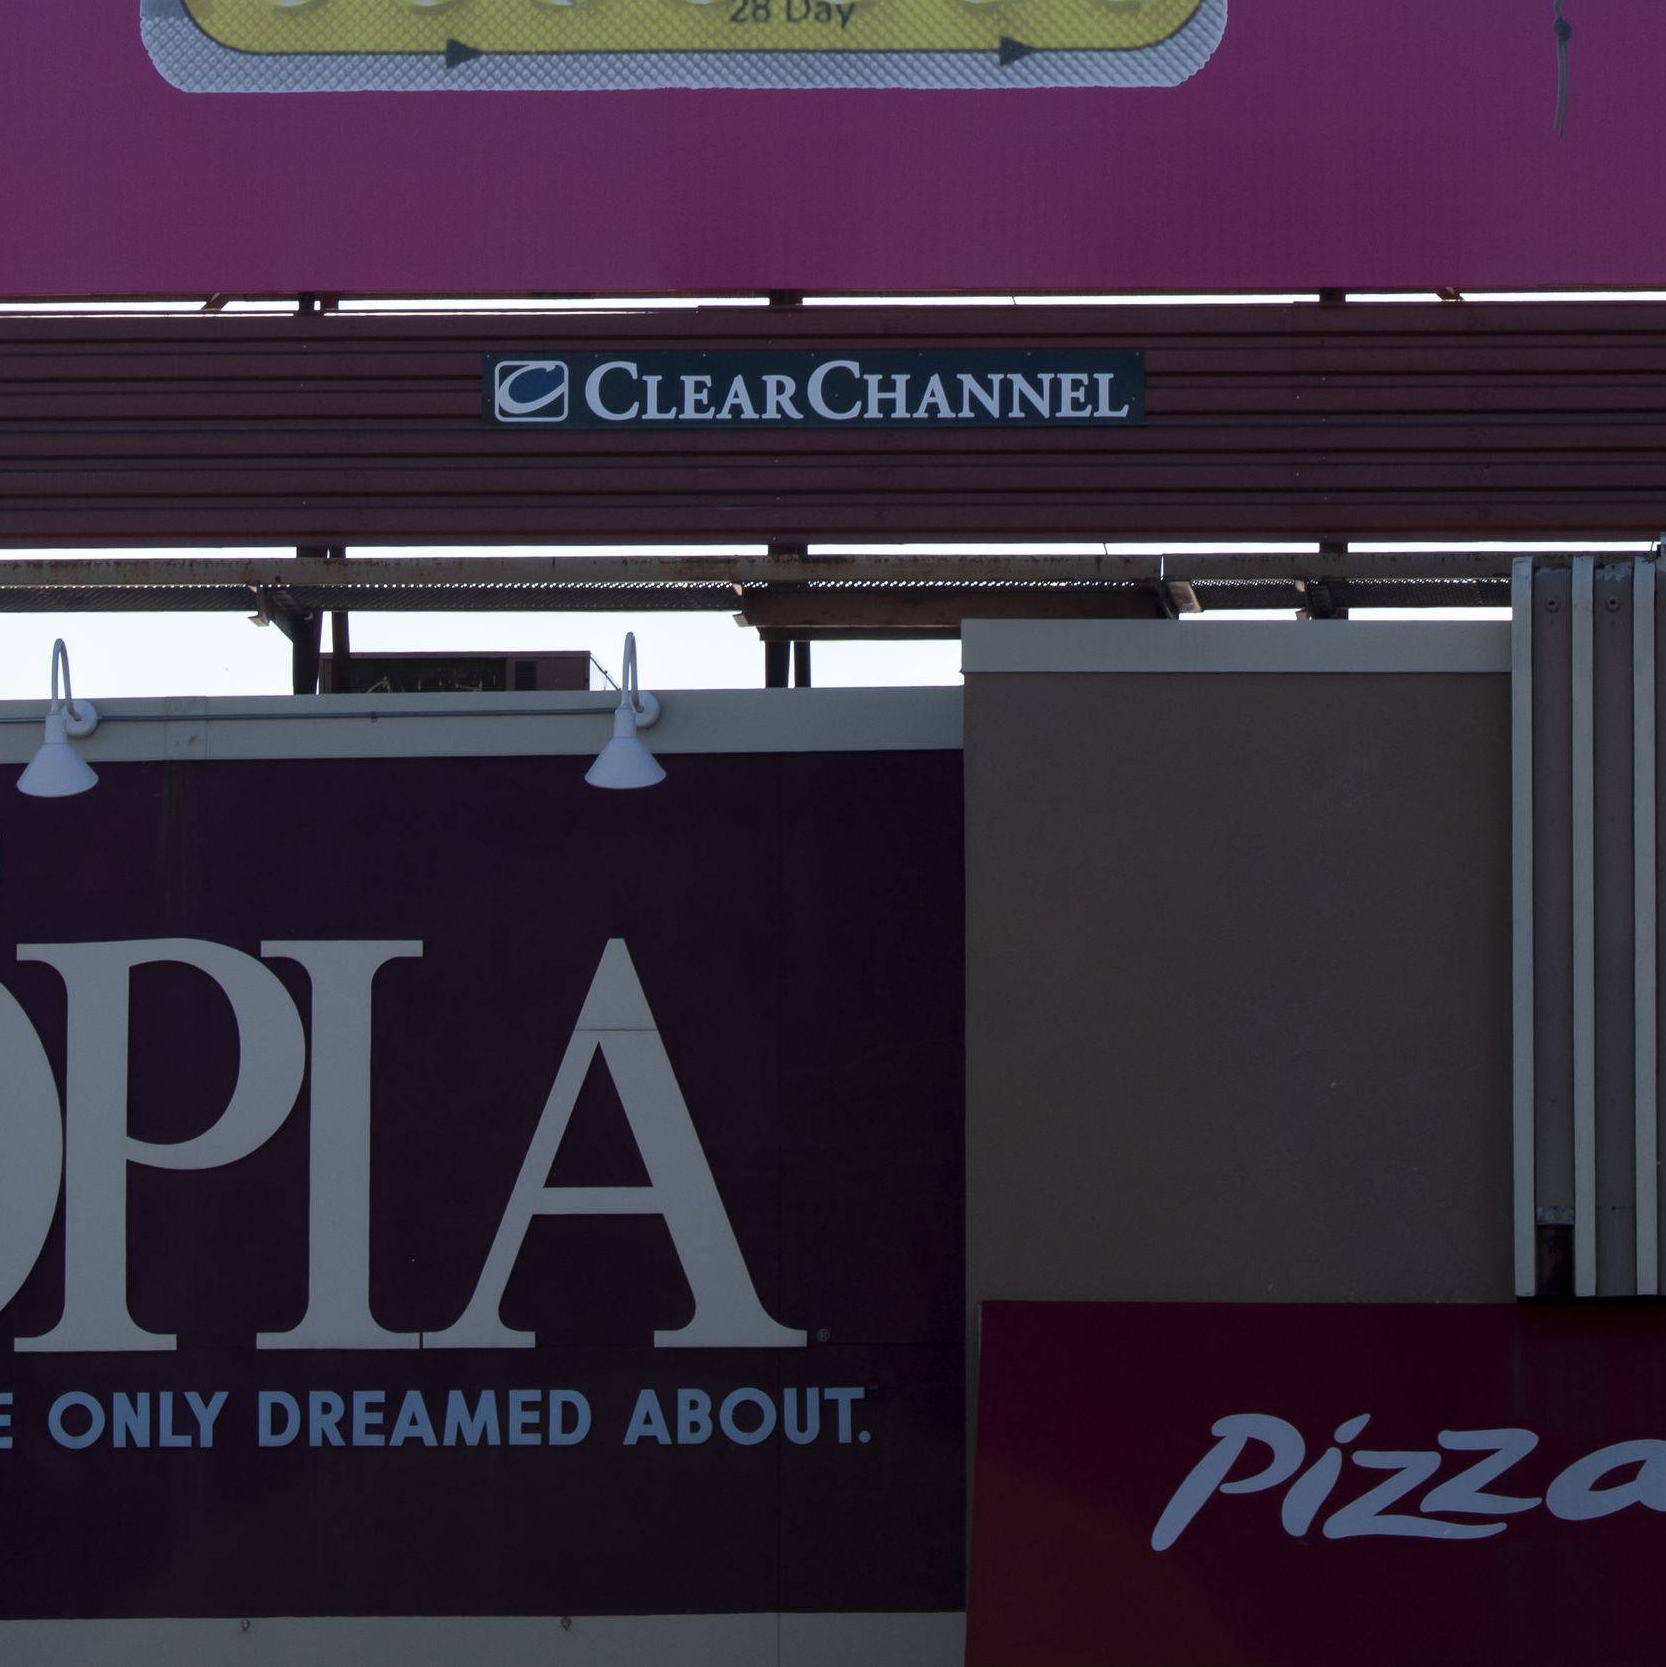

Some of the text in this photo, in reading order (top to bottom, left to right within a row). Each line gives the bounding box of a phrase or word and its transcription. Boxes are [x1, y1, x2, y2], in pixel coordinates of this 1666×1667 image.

[48, 1390, 230, 1450] ONLY
[258, 1389, 592, 1447] DREAMED
[622, 1386, 871, 1446] ABOUT.
